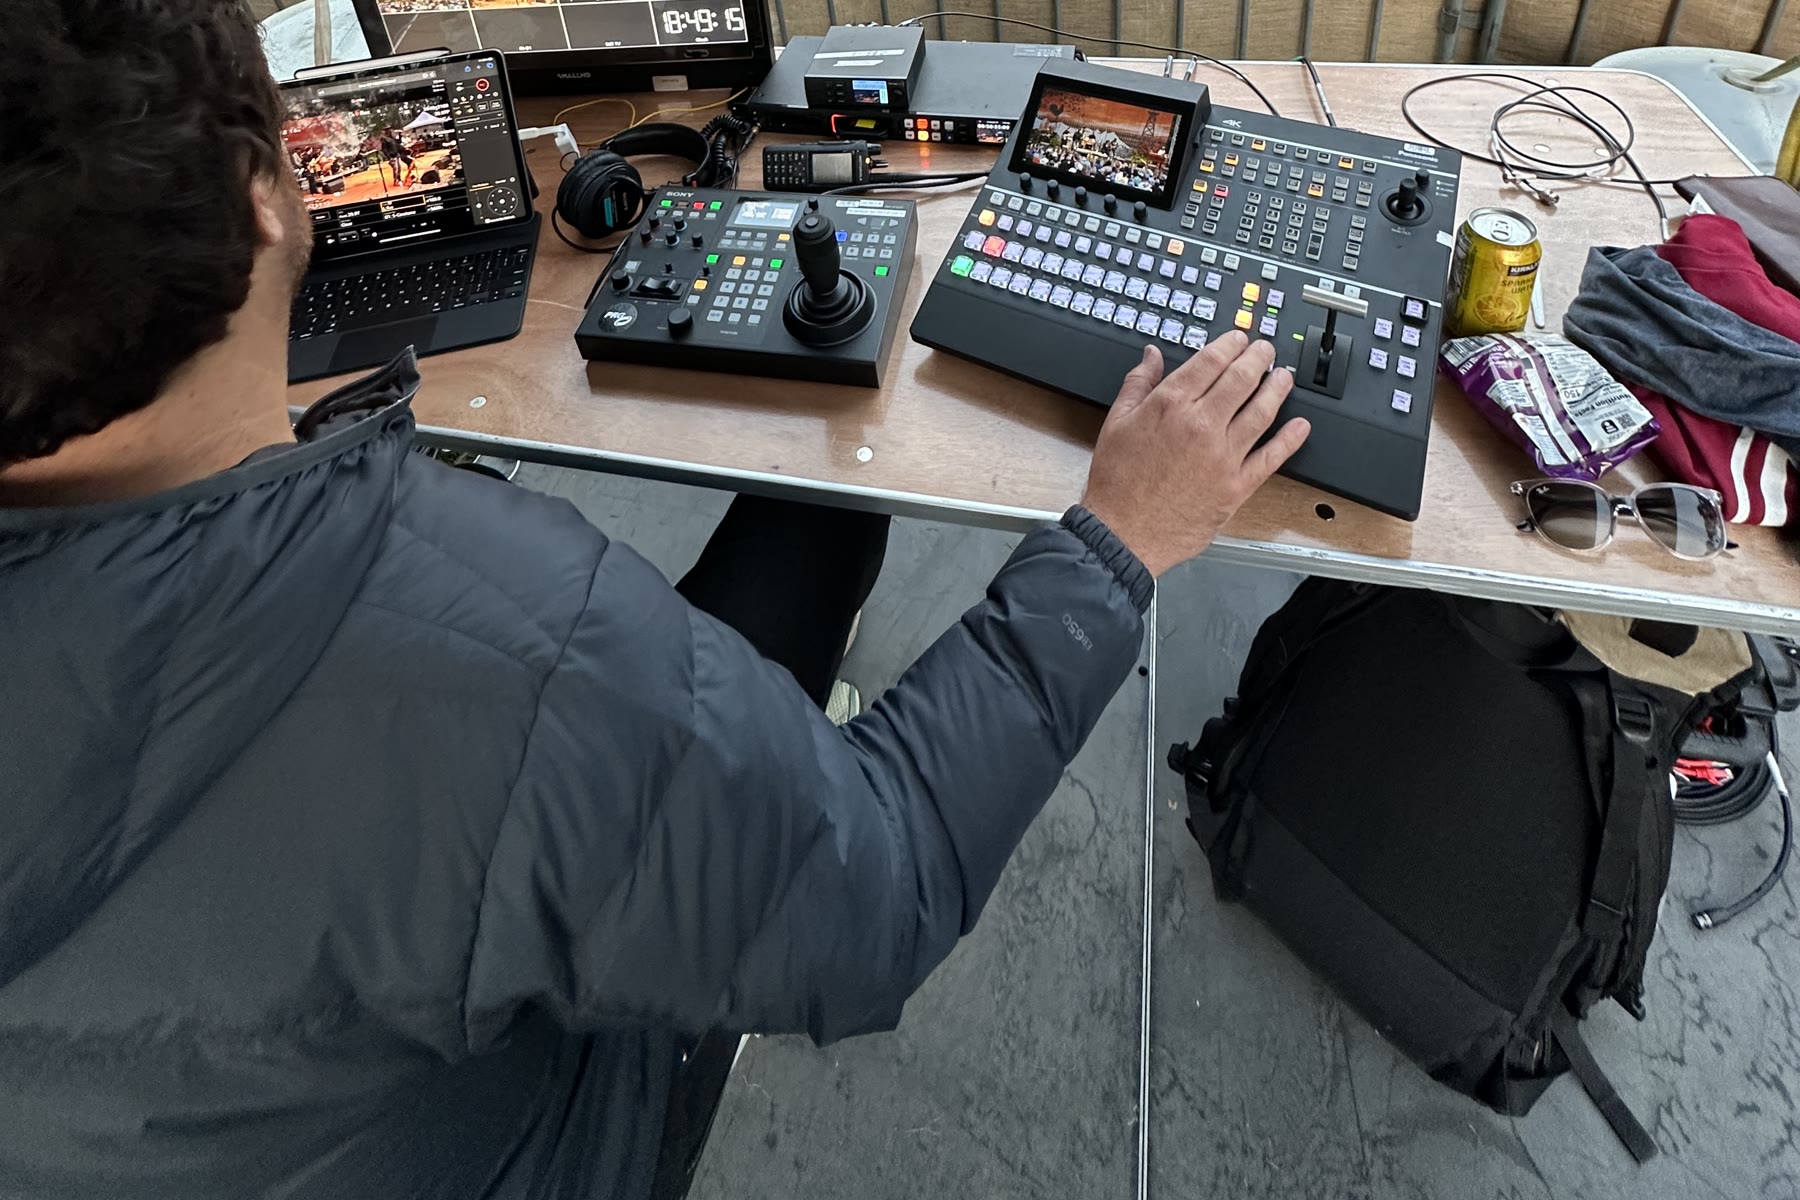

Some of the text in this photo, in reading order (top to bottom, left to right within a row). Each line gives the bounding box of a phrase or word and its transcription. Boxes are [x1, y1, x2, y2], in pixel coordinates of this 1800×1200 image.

[1222, 119, 1242, 128] 4K
[1398, 150, 1439, 163] Panasonic
[1564, 390, 1581, 398] 150
[1595, 394, 1632, 407] Nutrition
[1574, 405, 1596, 417] Facts
